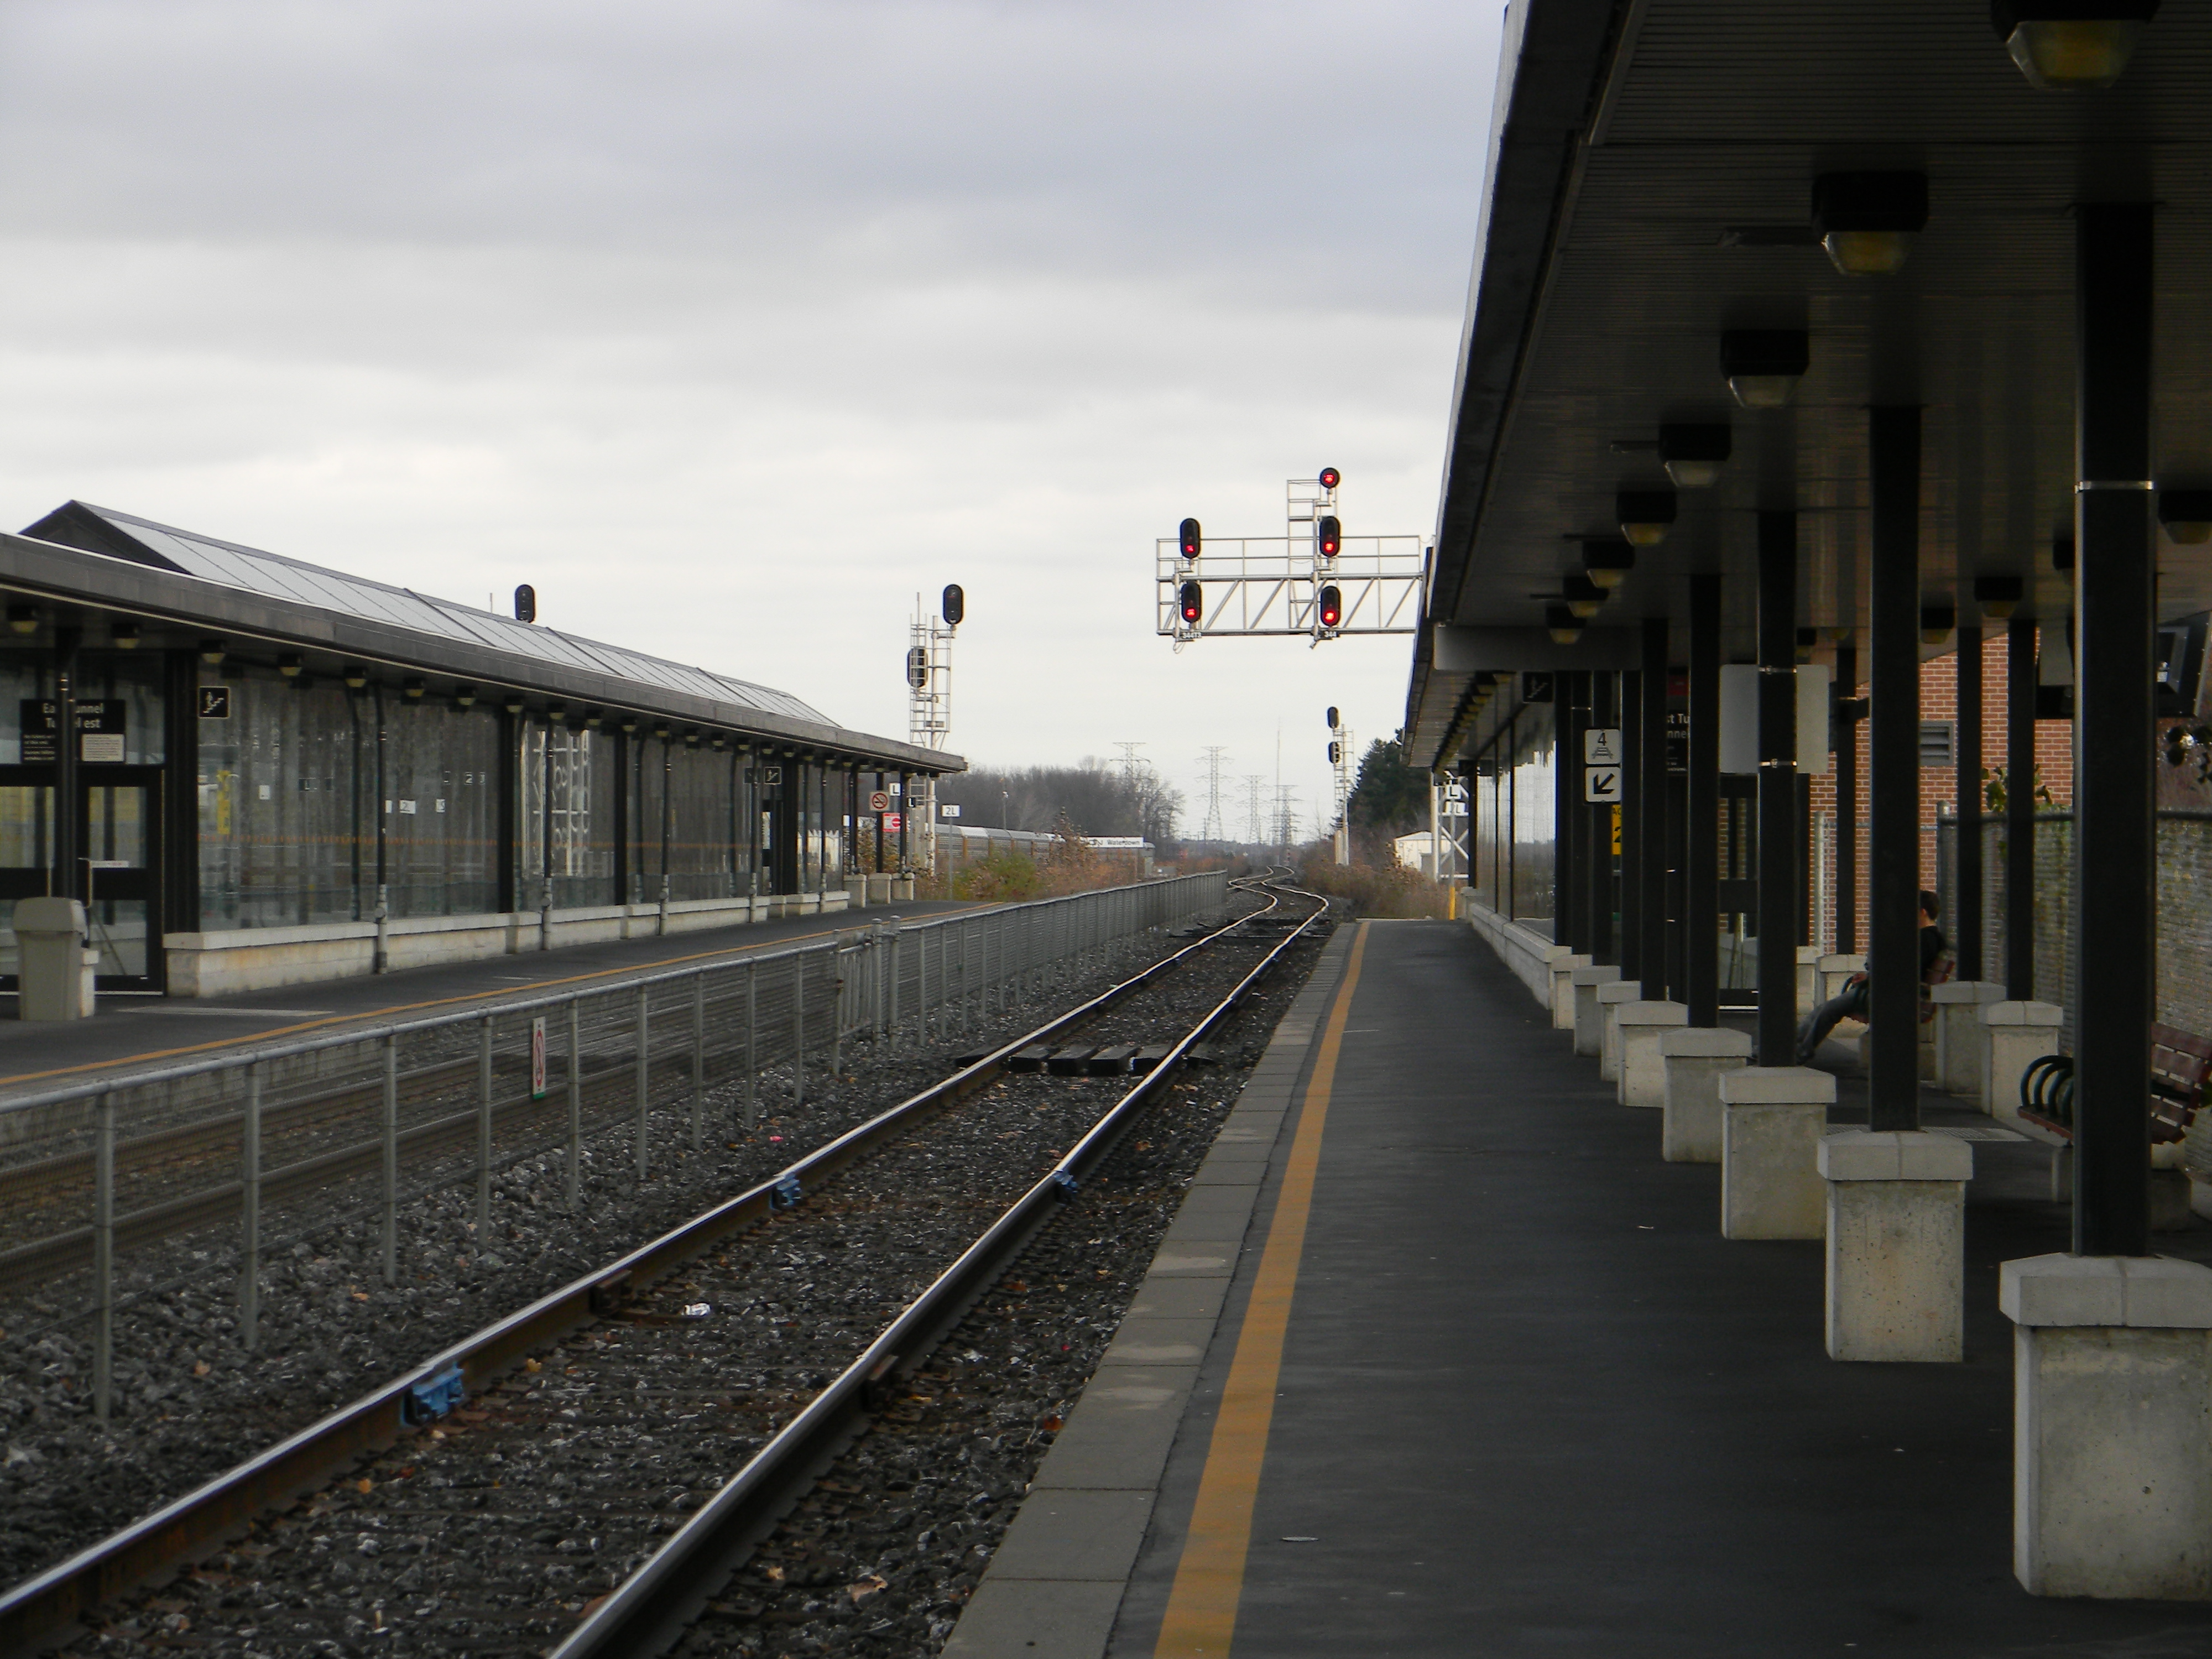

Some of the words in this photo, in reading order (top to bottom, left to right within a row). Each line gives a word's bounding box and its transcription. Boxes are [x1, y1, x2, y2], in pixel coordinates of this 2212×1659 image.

[43, 703, 56, 713] Ea
[75, 702, 105, 714] unnel
[83, 718, 101, 728] est
[1598, 732, 1606, 746] 4
[1667, 730, 1687, 739] nne
[893, 785, 900, 794] L
[1450, 786, 1458, 796] L
[908, 797, 914, 807] L
[946, 807, 956, 815] 2L
